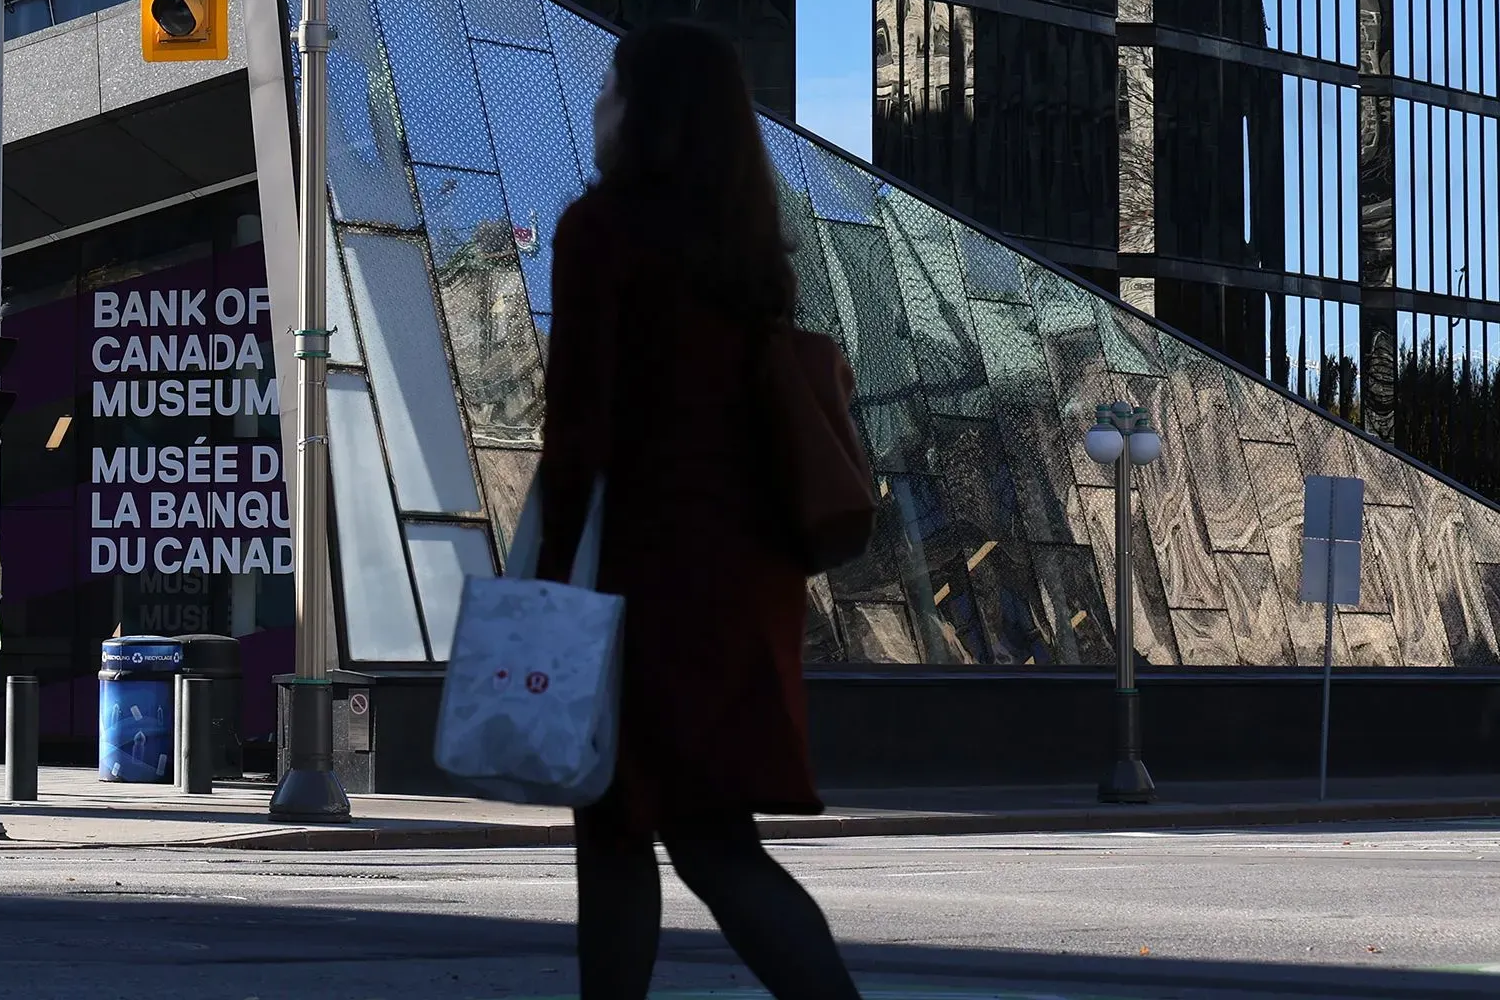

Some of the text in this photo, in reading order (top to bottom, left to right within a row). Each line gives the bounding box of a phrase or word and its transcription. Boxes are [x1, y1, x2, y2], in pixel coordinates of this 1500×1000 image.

[93, 287, 271, 328] BANK OF
[92, 333, 263, 373] CANADA
[92, 378, 280, 417] MUSEUM
[92, 436, 286, 483] MUSÉE D
[91, 490, 292, 529] LA BANQU
[90, 536, 294, 574] DU CANAD
